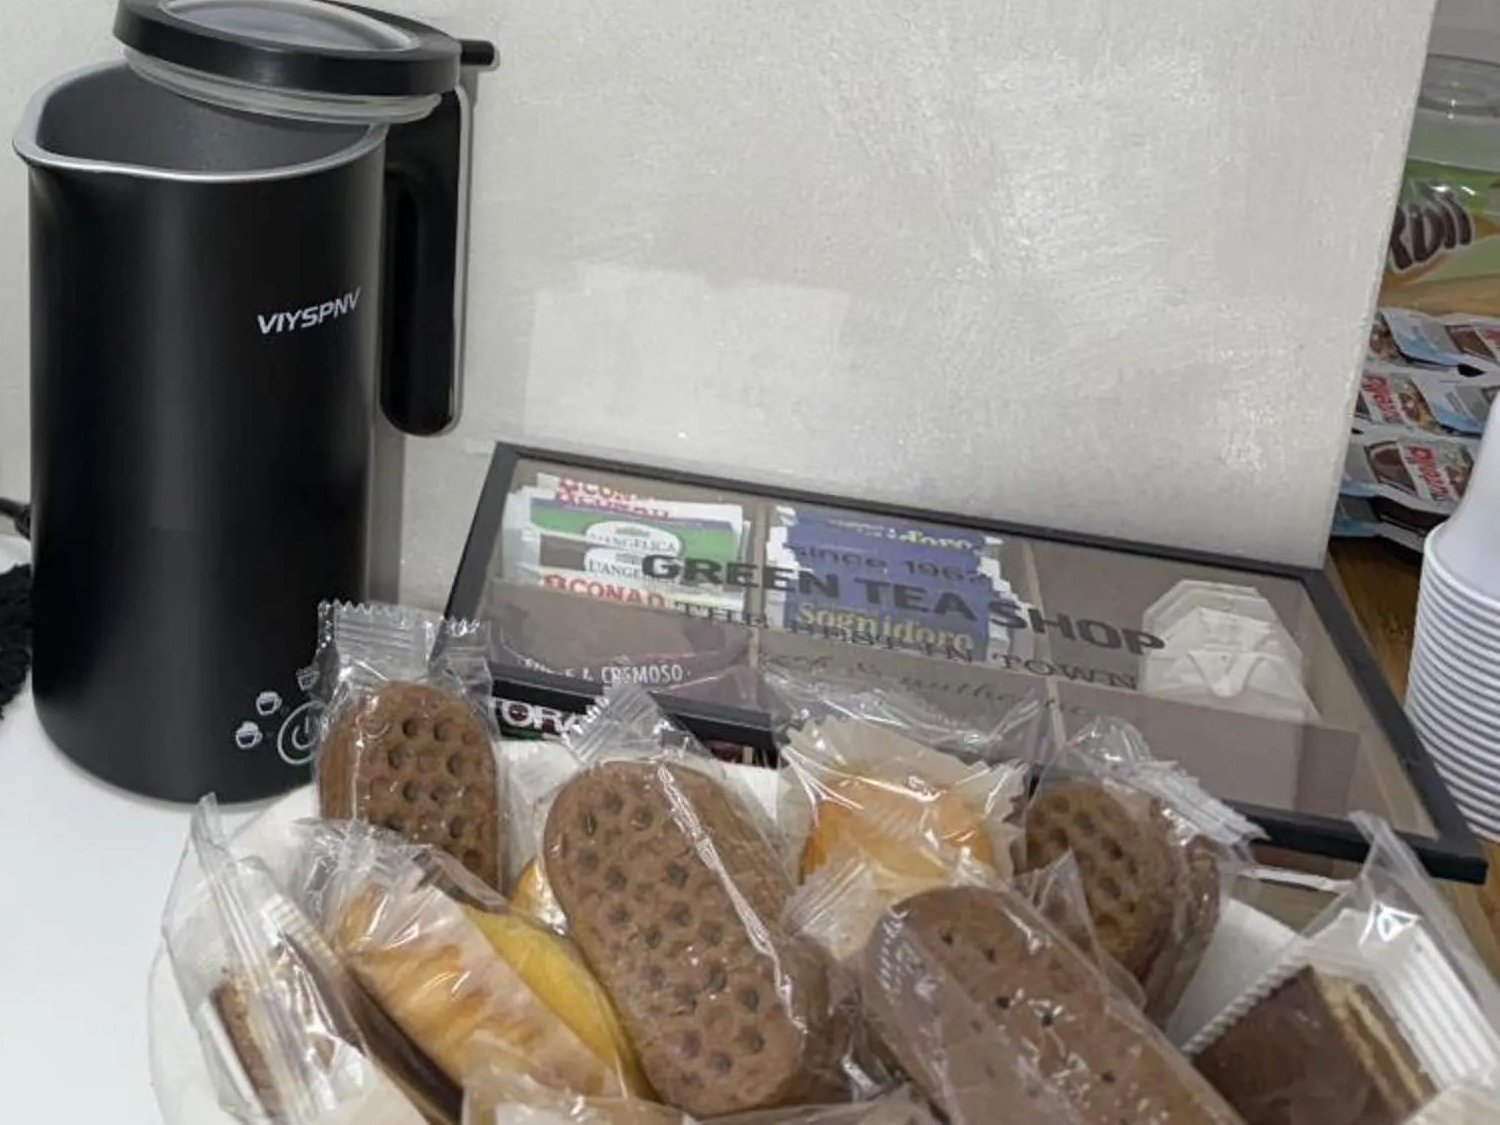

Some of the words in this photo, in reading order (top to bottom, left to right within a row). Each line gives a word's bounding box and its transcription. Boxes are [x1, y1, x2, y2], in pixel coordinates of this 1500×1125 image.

[257, 286, 361, 335] VIYSPNV
[641, 554, 840, 598] GREEN
[853, 575, 977, 622] TEA
[988, 599, 1165, 656] SHOP
[991, 651, 1141, 691] TOWN
